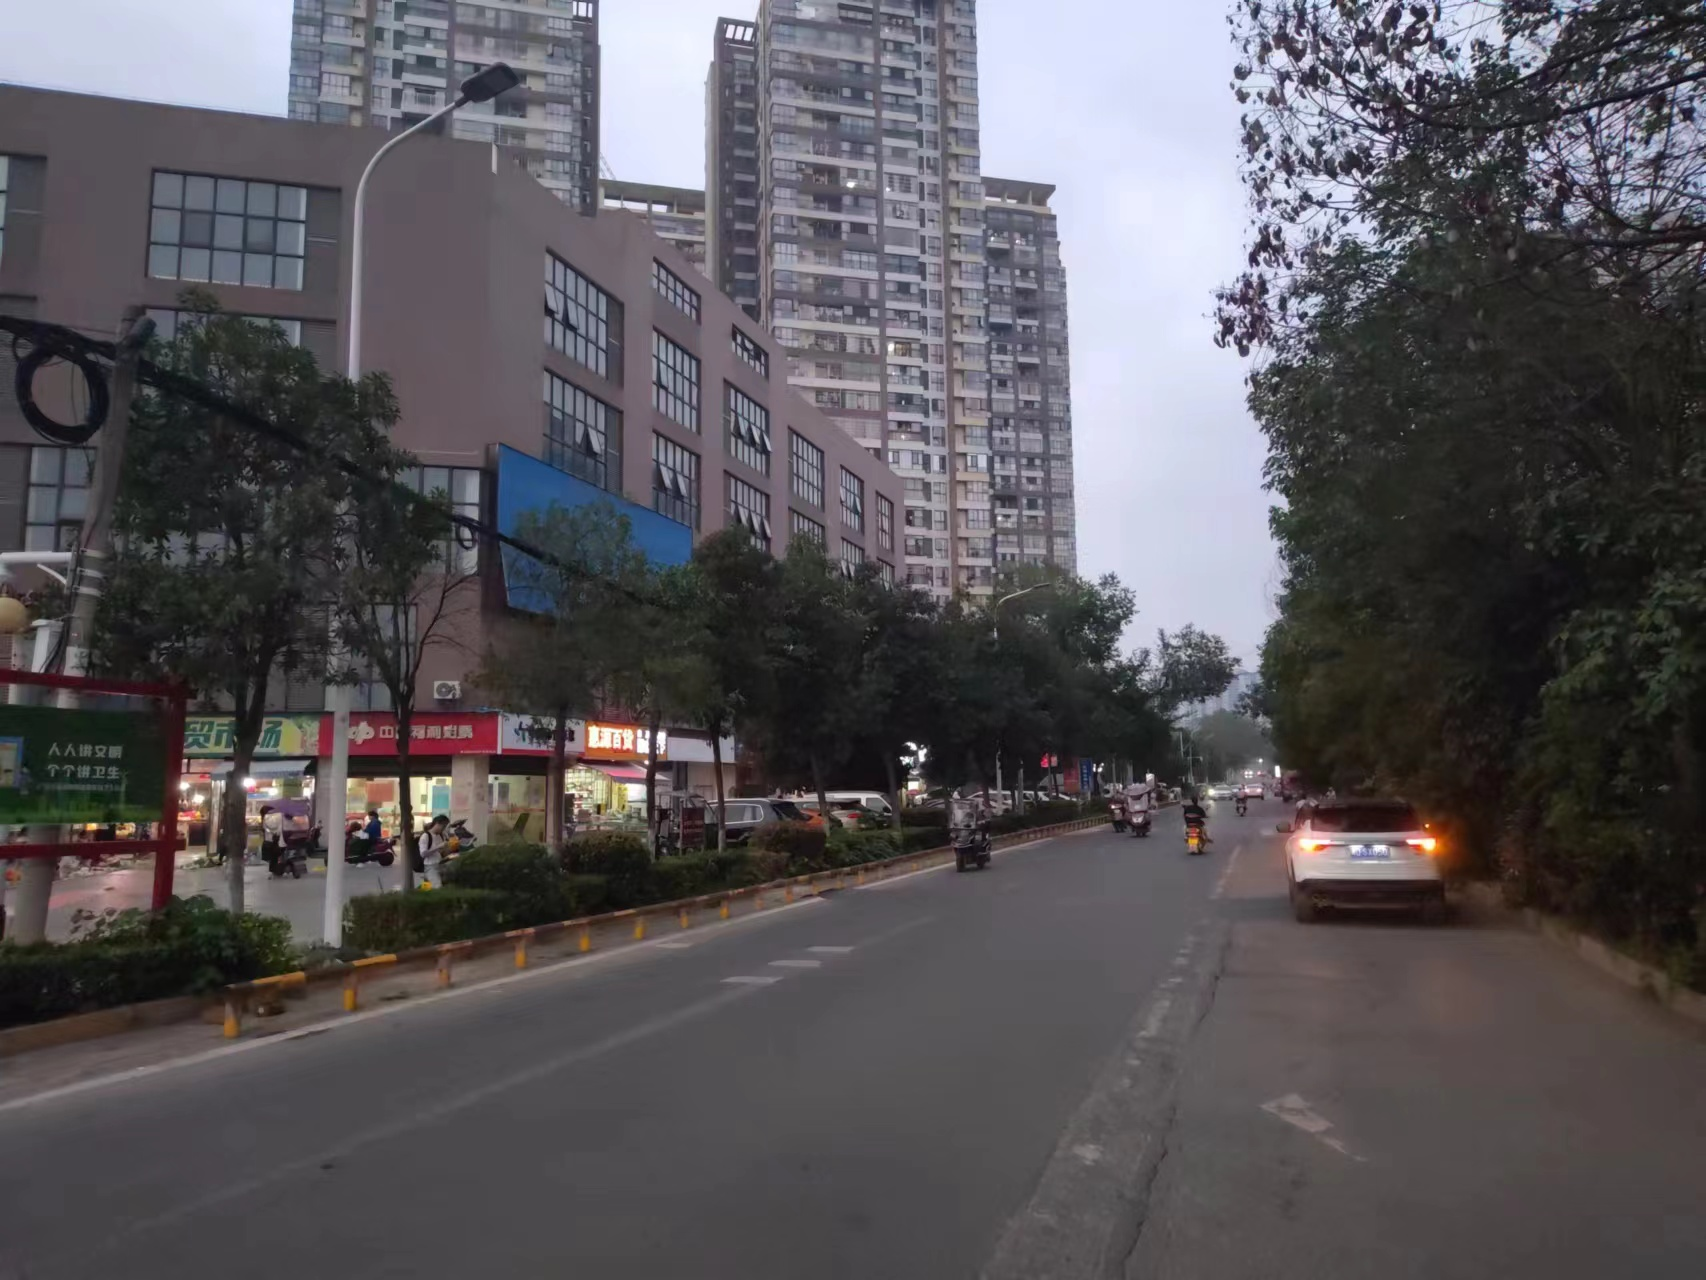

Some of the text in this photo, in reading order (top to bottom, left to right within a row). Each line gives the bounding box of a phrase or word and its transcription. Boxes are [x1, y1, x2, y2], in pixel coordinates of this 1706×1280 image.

[379, 725, 473, 739] 中福利彩票
[48, 742, 123, 758] 人人讲文明
[47, 764, 120, 780] 个个讲卫生
